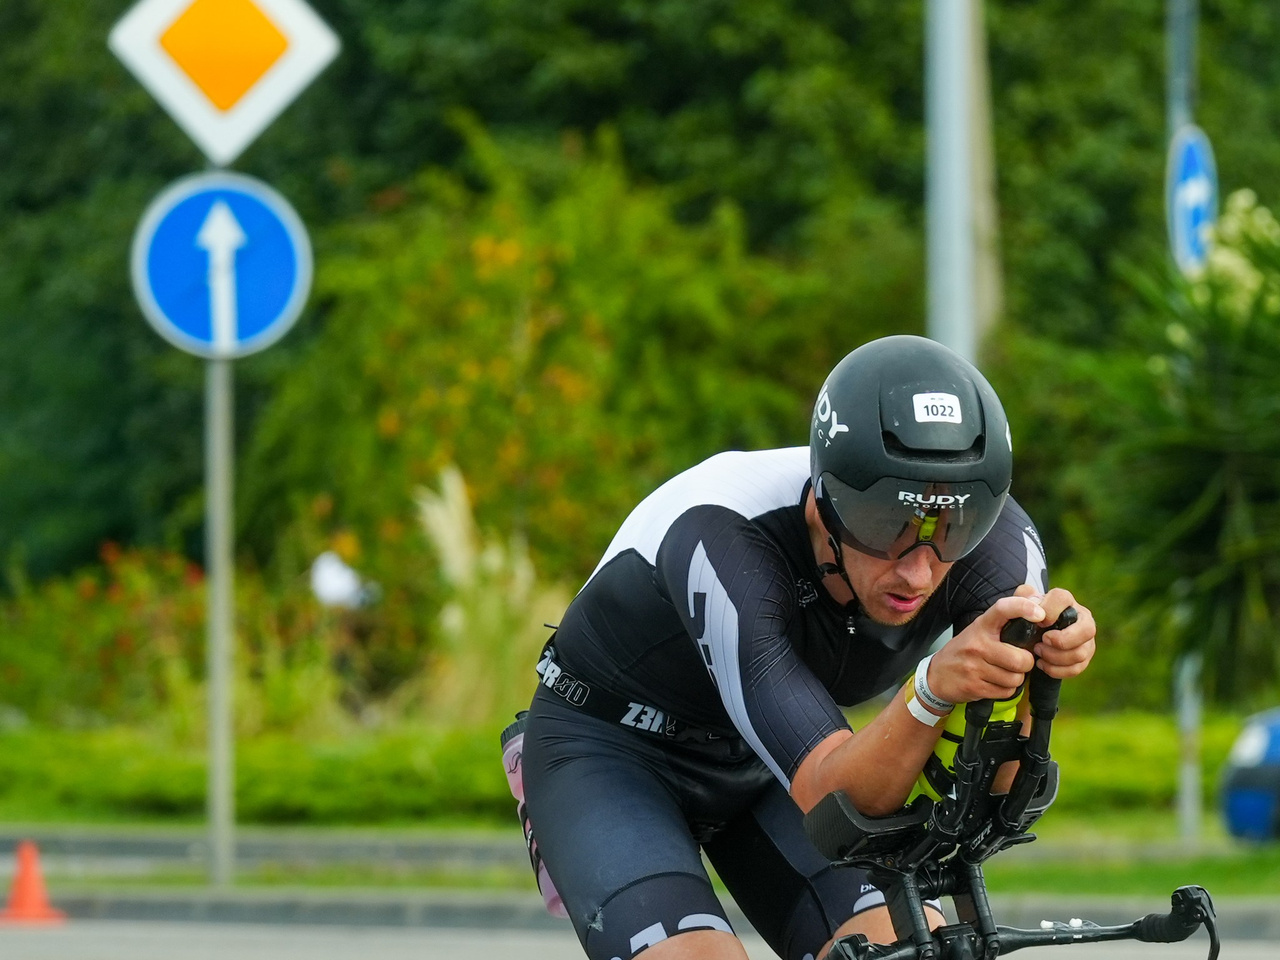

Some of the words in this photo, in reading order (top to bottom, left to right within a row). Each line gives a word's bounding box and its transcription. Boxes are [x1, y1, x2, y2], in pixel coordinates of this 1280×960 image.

[923, 404, 955, 417] 1022
[898, 490, 971, 505] RUDY
[903, 501, 964, 510] PROJECT
